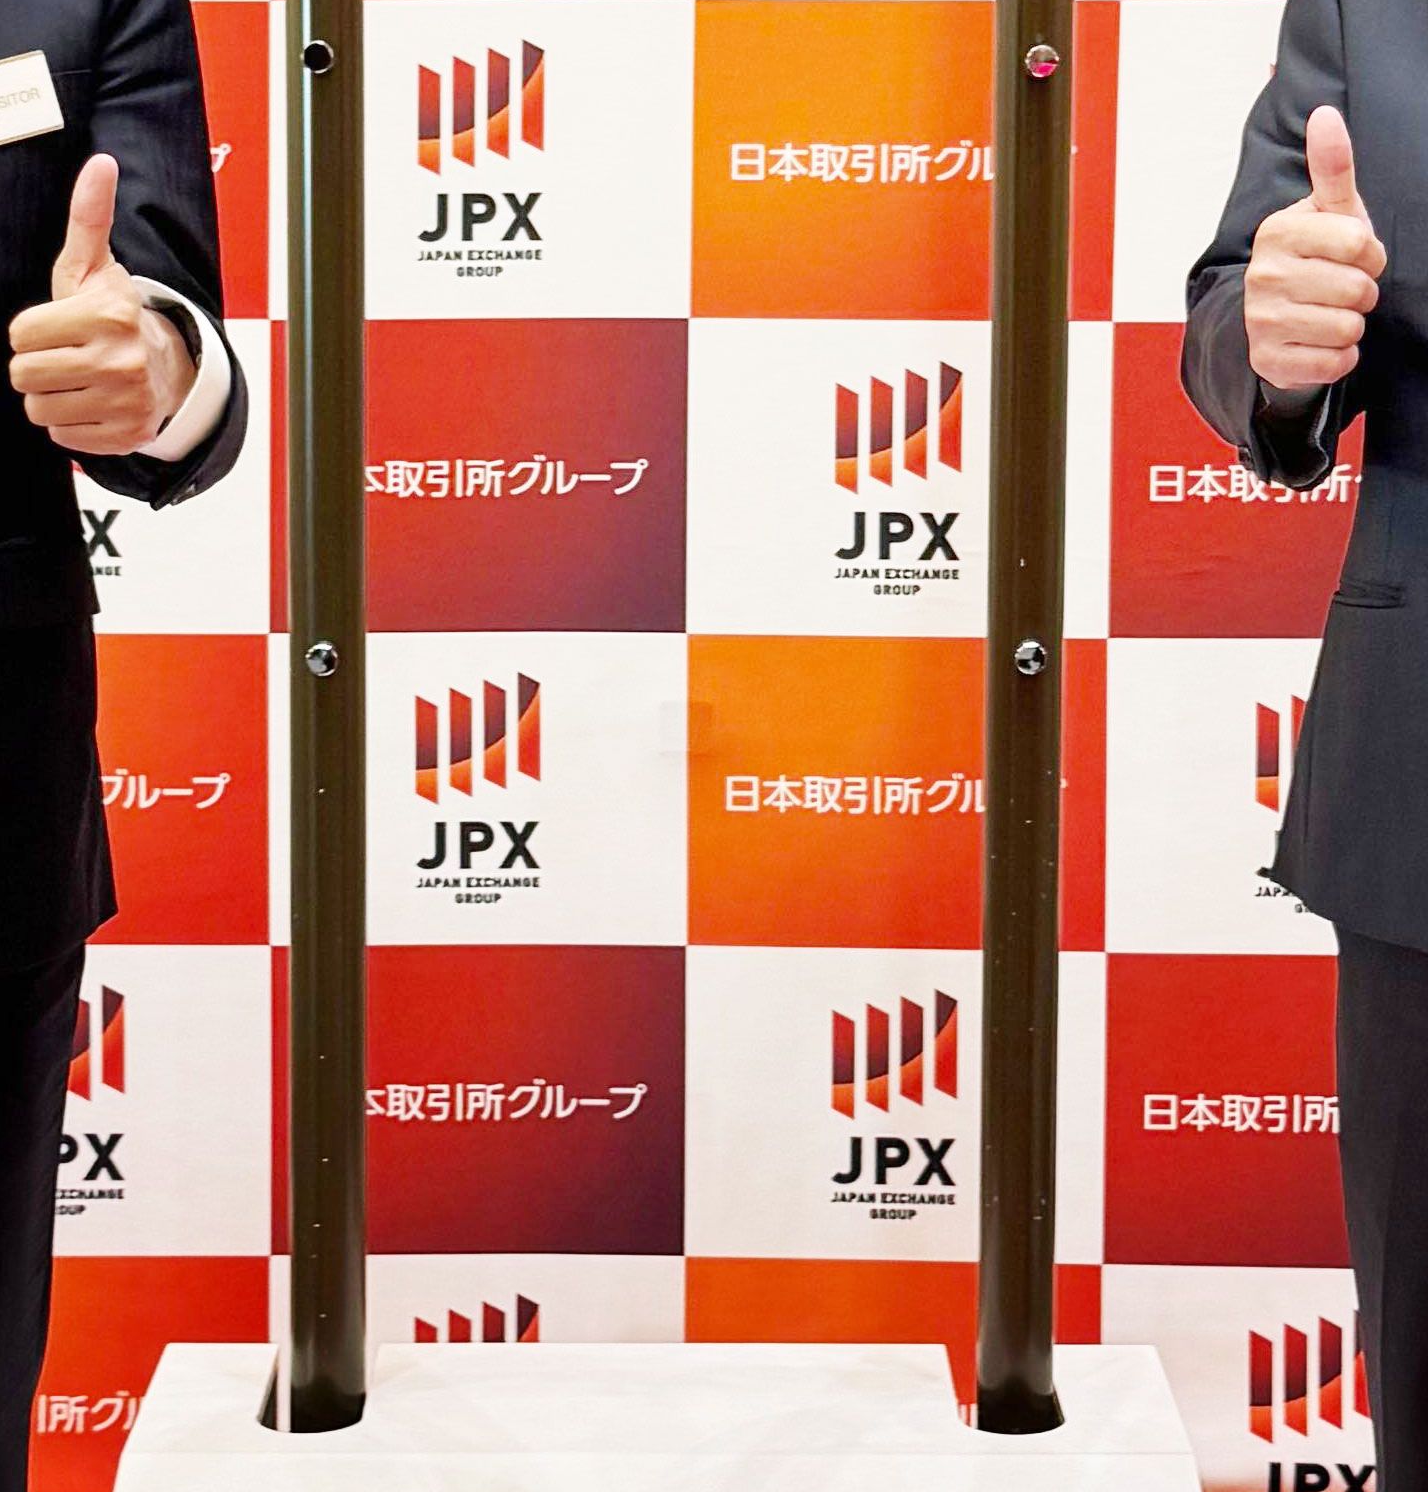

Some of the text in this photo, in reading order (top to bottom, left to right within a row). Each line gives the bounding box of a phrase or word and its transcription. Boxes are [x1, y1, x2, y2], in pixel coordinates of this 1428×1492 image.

[418, 192, 542, 242] JPX
[417, 249, 542, 262] JAPAN EXCHANGE
[456, 266, 504, 278] GROUP
[835, 511, 960, 561] JPX
[834, 567, 960, 580] JAPAN EXCHANGE
[873, 584, 922, 596] GROUP
[416, 821, 540, 870] JPX
[415, 876, 540, 889] JAPAN EXCHANGE
[454, 892, 502, 905] GROUP
[832, 1136, 956, 1187] JPX
[830, 1191, 956, 1206] JAPAN EXCHANGE
[869, 1208, 918, 1221] GROUP
